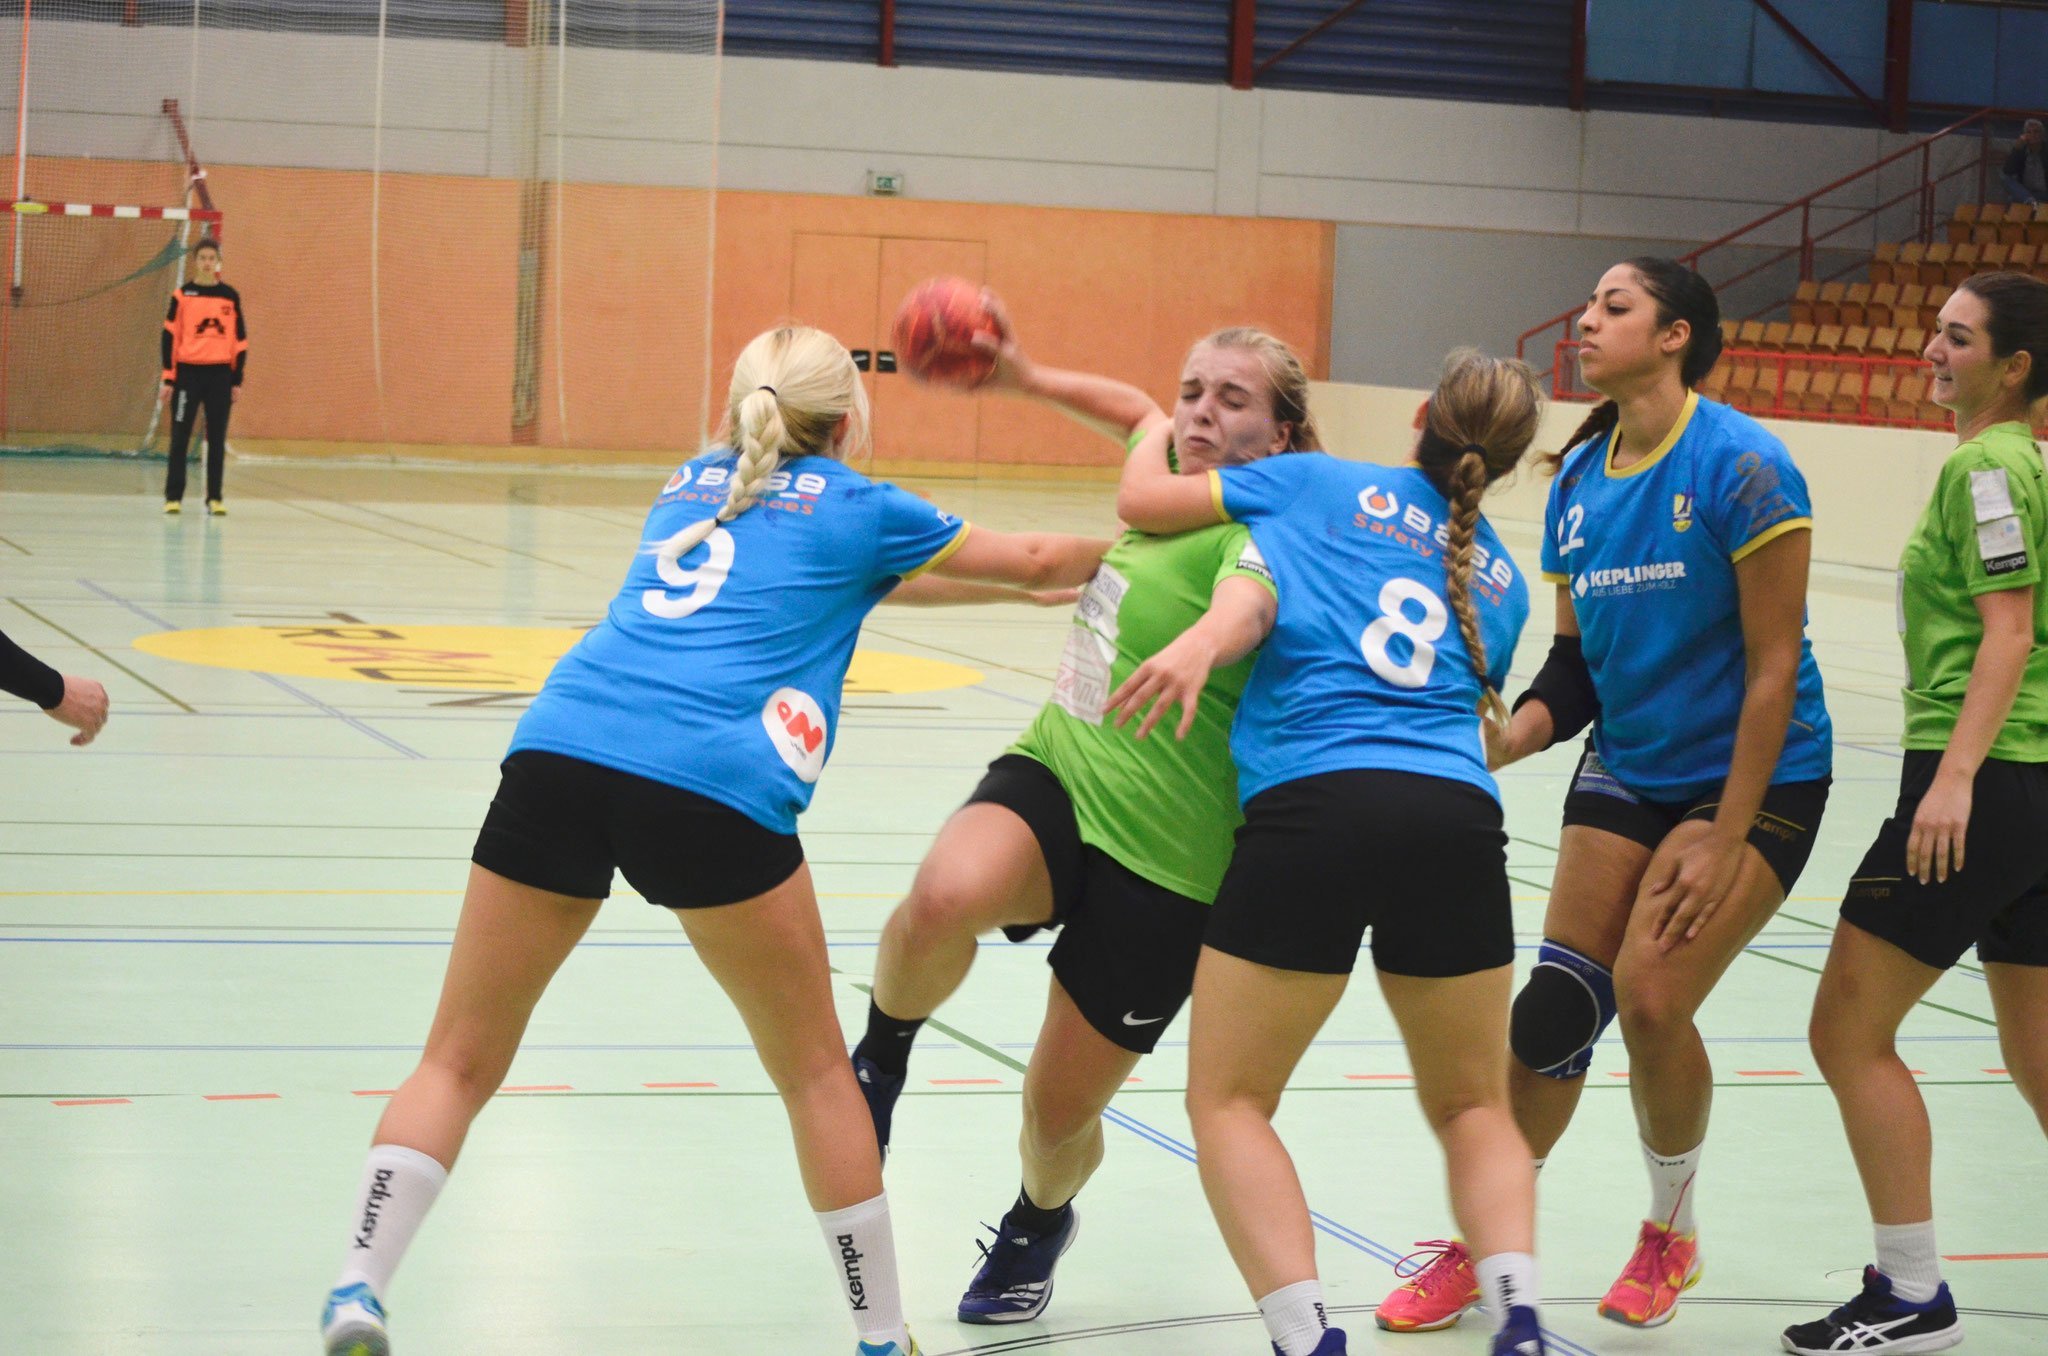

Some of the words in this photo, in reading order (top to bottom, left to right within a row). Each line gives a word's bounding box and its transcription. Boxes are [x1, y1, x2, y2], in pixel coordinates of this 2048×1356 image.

[696, 467, 827, 495] Bse
[642, 527, 735, 619] 9
[1238, 561, 1273, 581] Kemp
[1590, 562, 1687, 587] KEPLINGER
[1986, 555, 2026, 572] Kempa
[1360, 578, 1448, 688] 8
[354, 1168, 393, 1250] Kempa
[837, 1233, 869, 1311] Kempa
